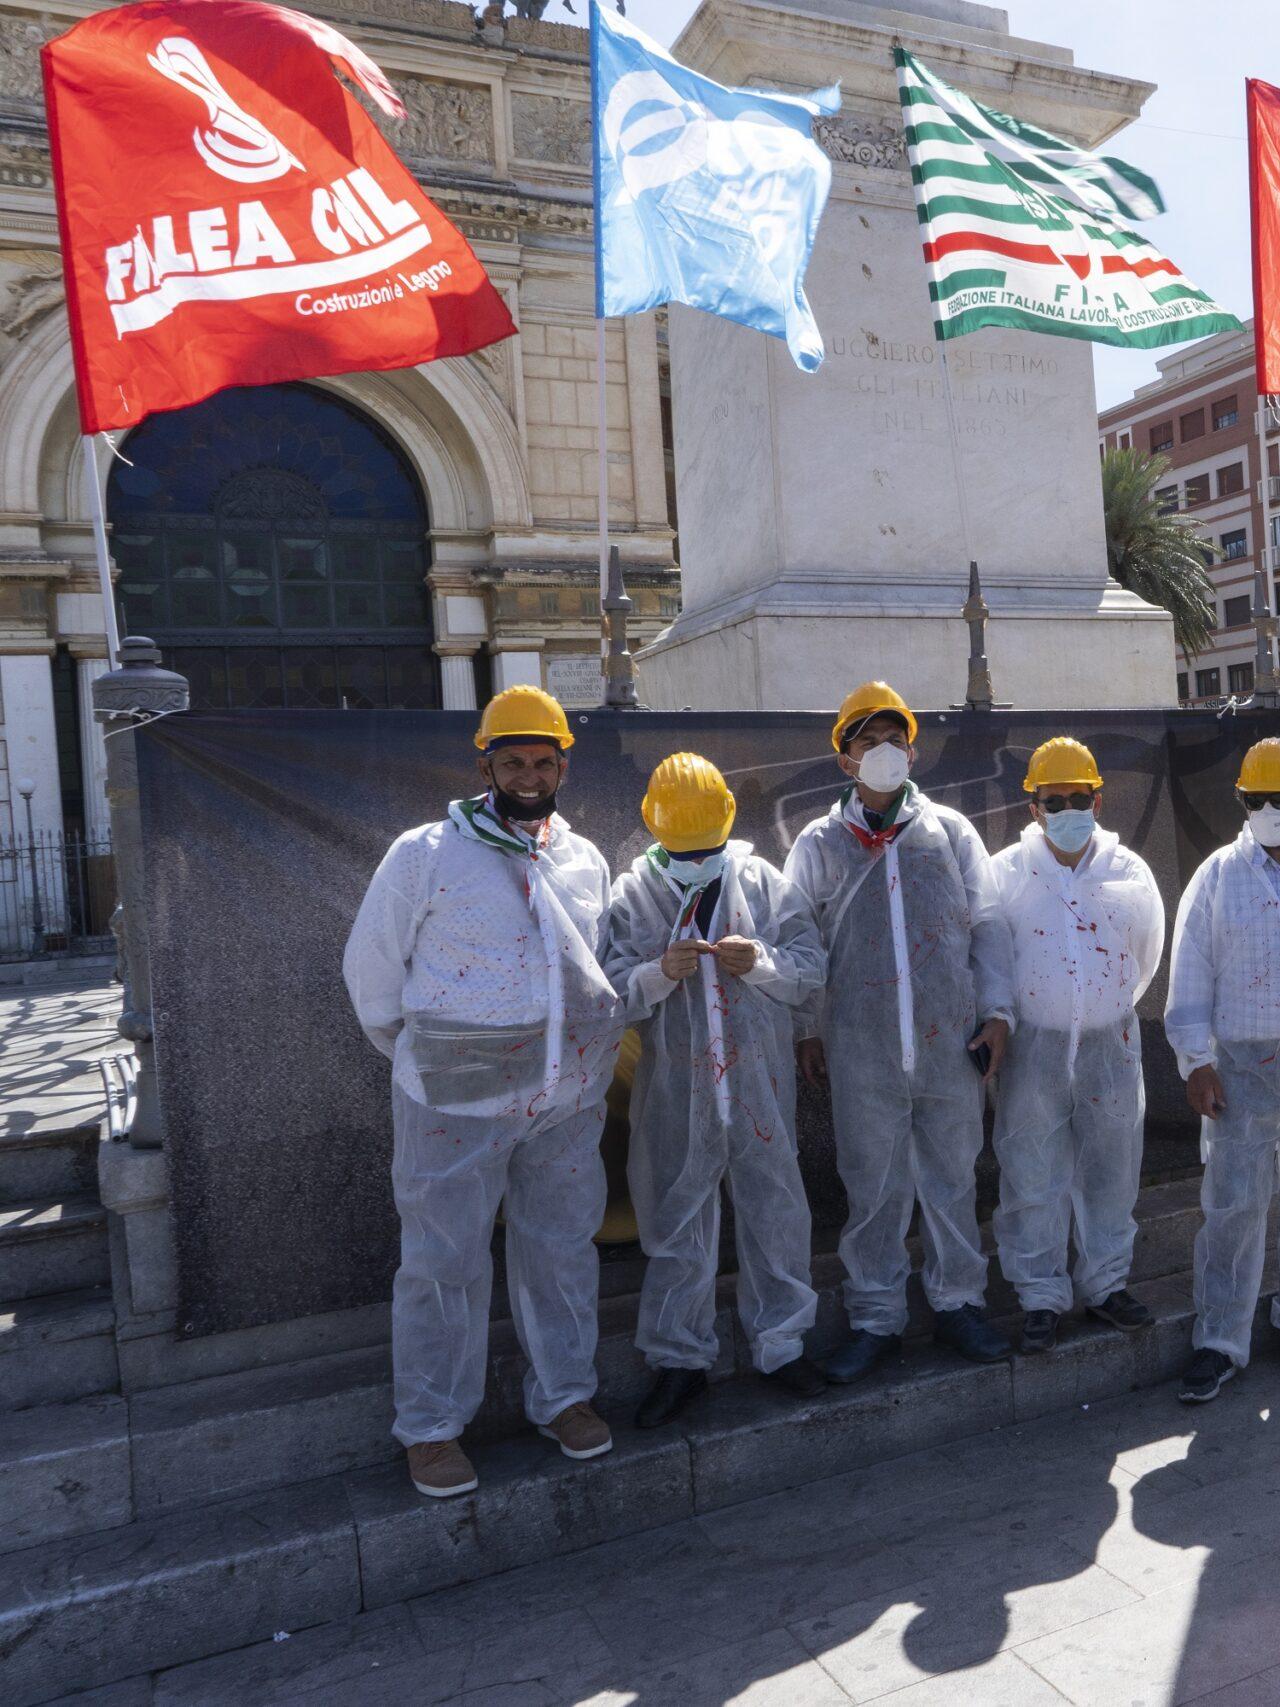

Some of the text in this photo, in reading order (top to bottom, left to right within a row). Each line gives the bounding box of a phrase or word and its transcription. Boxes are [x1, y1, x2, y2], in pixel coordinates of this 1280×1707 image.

[295, 260, 453, 316] Costruzioni e Legno
[1001, 291, 1065, 319] ITALIANA
[826, 336, 935, 364] UGGIERO
[914, 378, 1028, 406] ITLIANI
